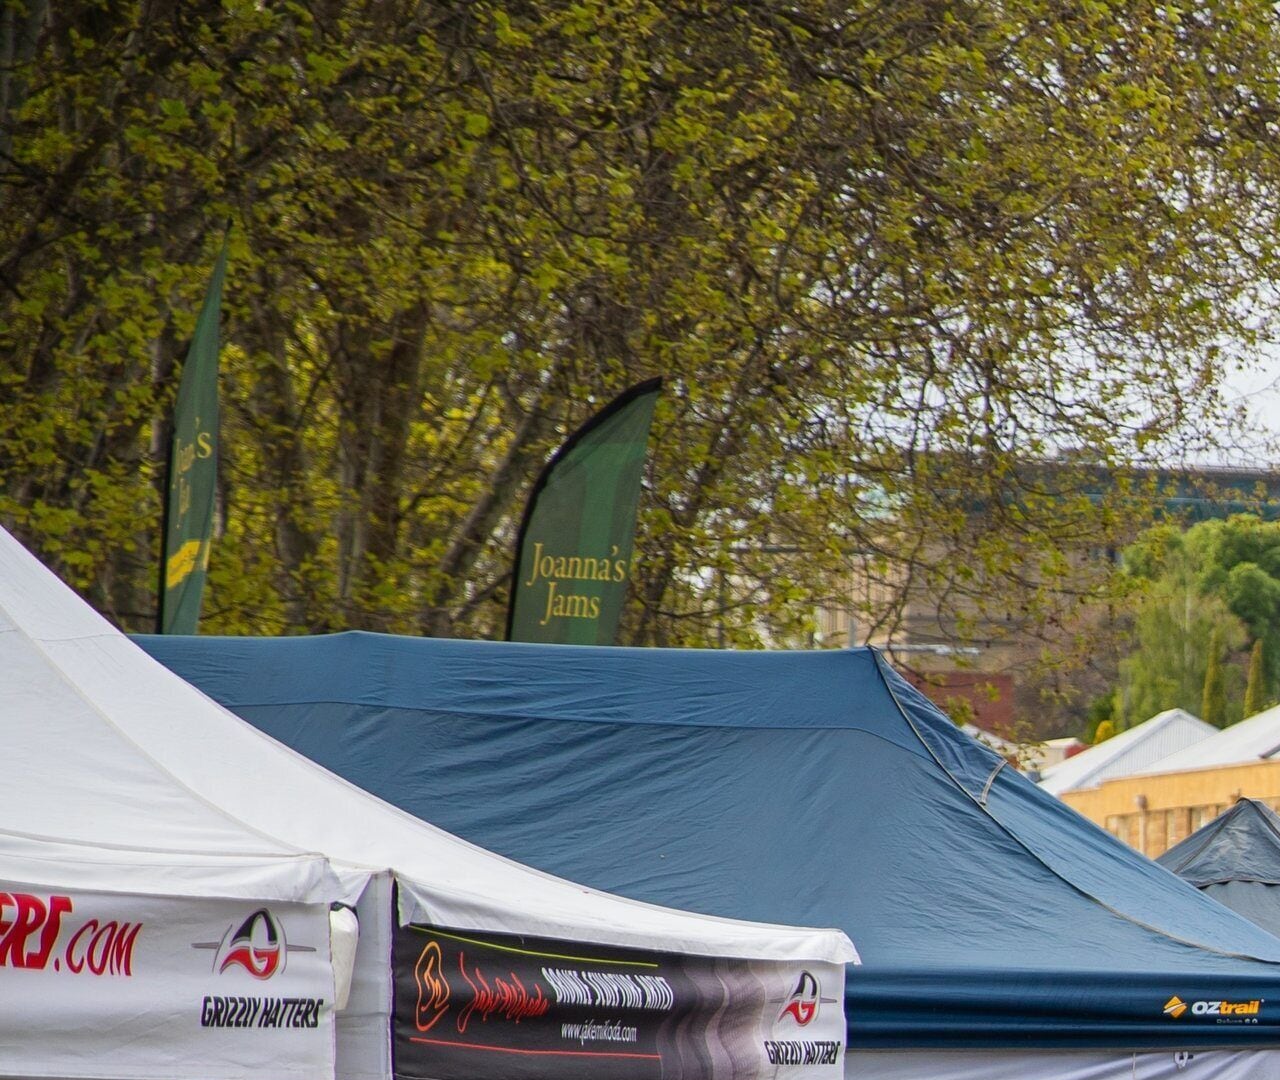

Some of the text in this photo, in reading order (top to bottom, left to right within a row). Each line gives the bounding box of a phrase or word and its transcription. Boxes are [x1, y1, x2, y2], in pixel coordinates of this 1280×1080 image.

[525, 543, 626, 586] Joanna's
[540, 582, 601, 626] Jams
[200, 995, 324, 1029] GRIZZLY HATTERS
[1191, 1000, 1260, 1016] OZtrail
[763, 1040, 841, 1066] GRIZZLY HATTERS
